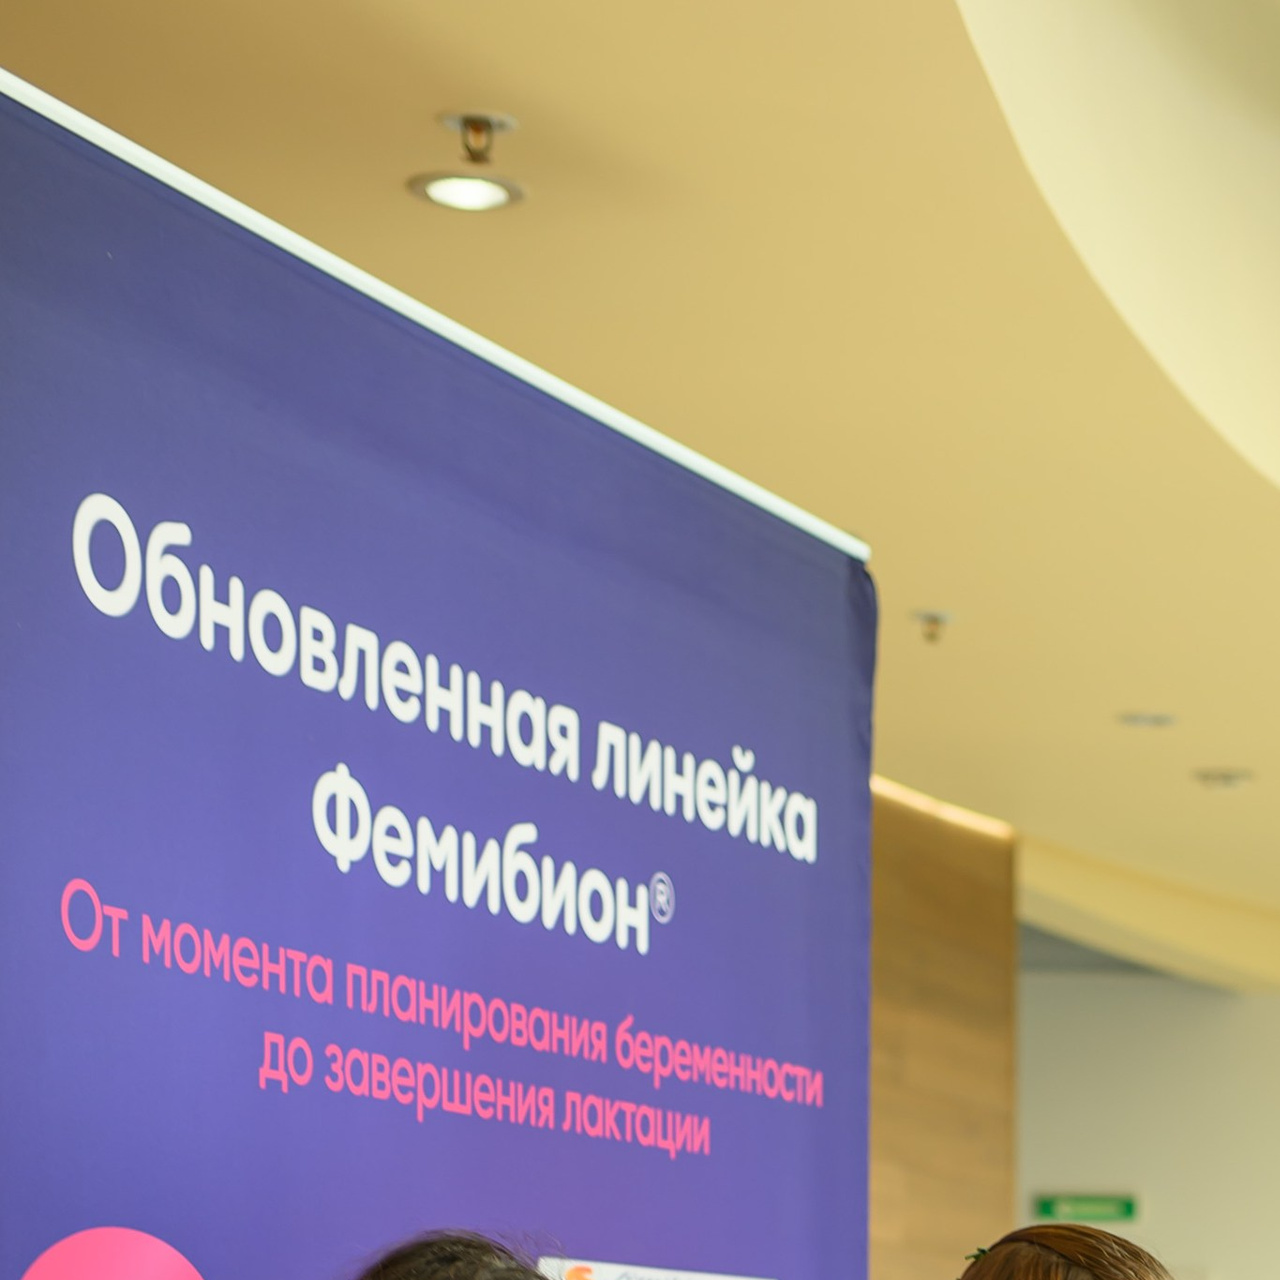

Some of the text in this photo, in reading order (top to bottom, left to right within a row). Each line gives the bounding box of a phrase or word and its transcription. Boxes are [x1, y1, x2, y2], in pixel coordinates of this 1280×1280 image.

[73, 493, 817, 863] Обновленная линейка
[61, 878, 823, 1107] От момента планирования беременности
[258, 1031, 710, 1159] до завершения лактации
